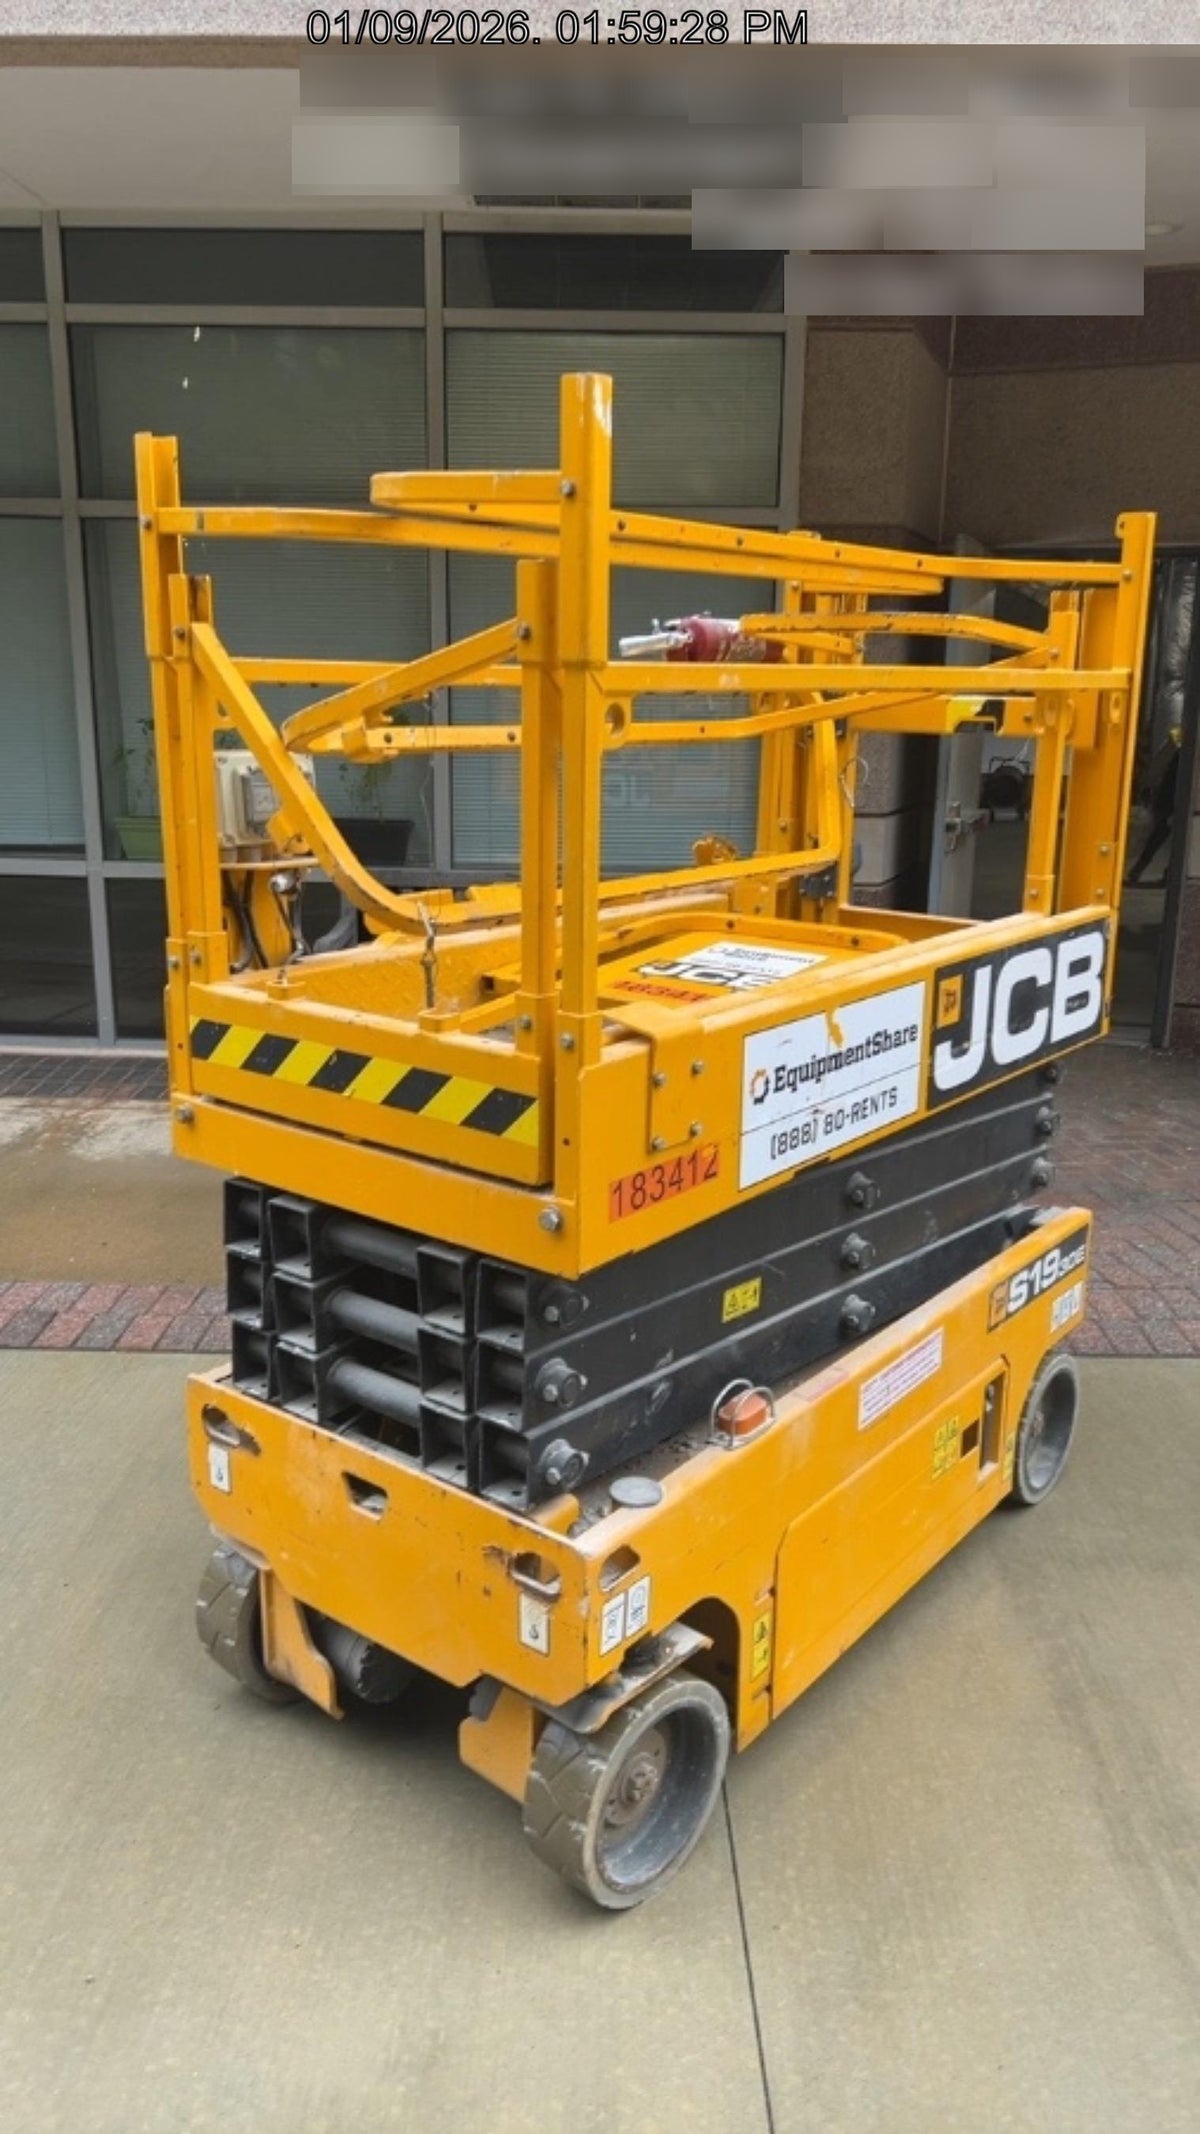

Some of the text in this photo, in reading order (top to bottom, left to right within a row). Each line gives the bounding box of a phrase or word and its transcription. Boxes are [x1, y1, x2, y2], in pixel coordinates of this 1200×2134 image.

[934, 931, 1104, 1091] JCB
[772, 1022, 919, 1093] EquipmentShare
[770, 1117, 818, 1160] (888)
[612, 1143, 719, 1217] 183412
